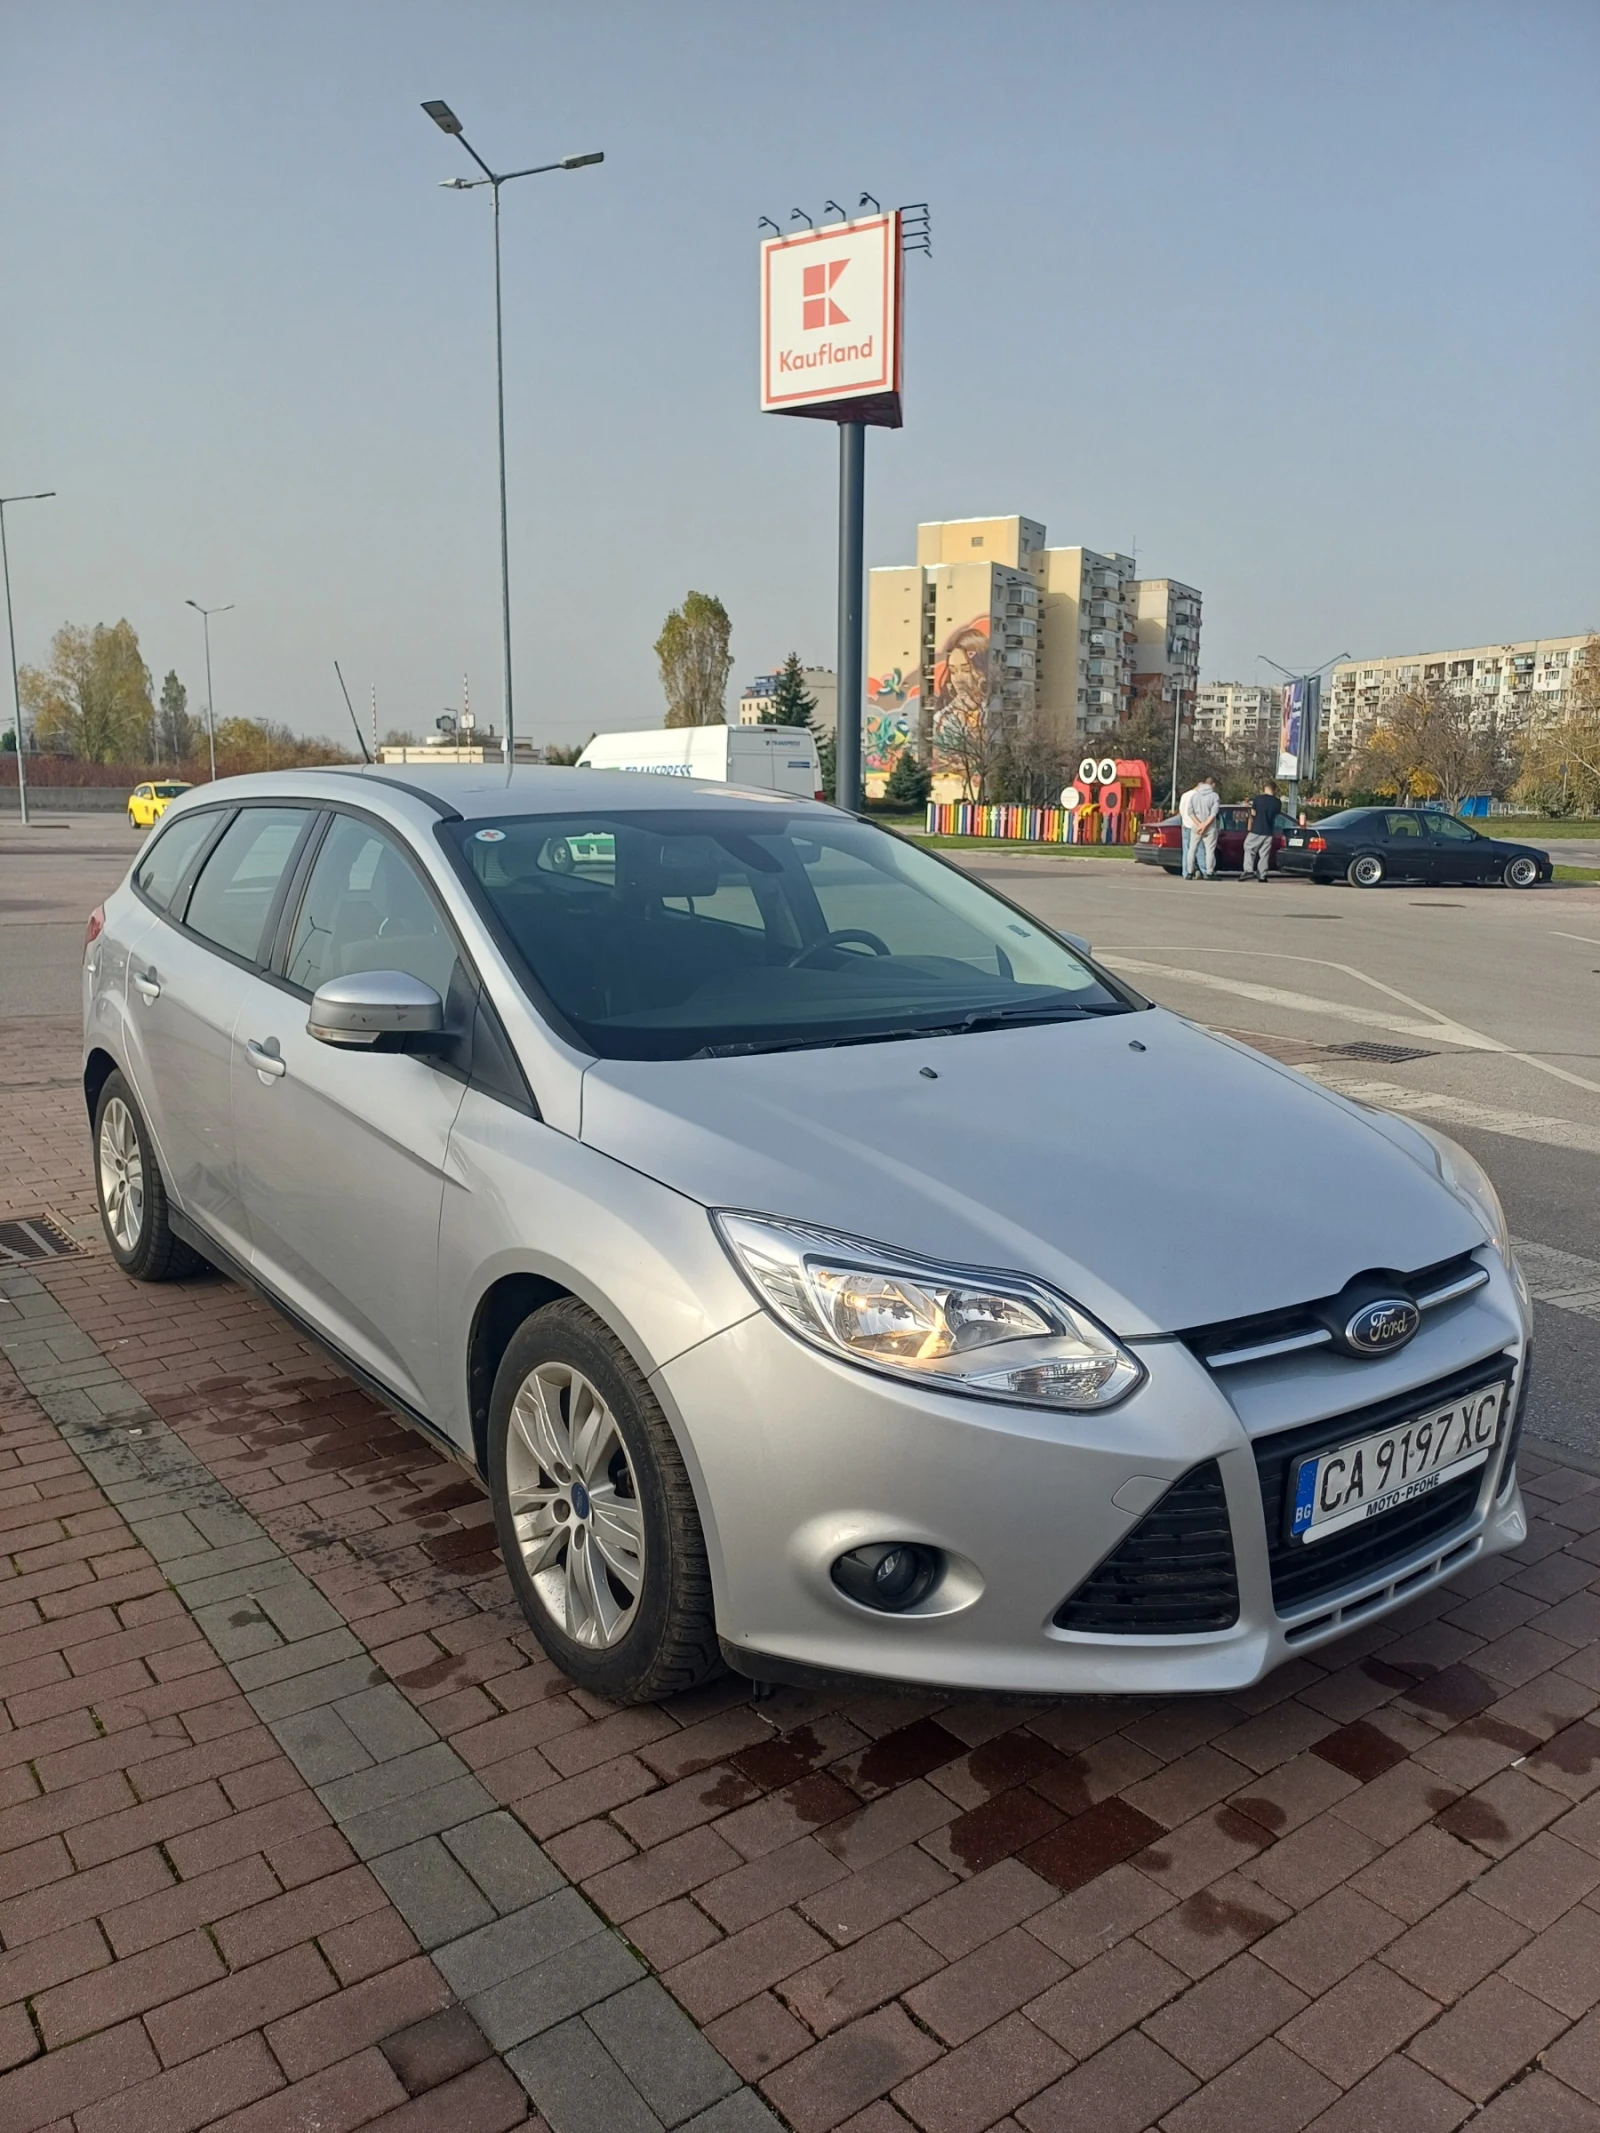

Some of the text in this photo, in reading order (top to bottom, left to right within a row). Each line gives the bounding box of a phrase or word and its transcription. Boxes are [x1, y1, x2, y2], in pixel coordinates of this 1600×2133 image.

[803, 258, 851, 330] K
[779, 335, 873, 372] Kaufland
[1370, 1308, 1408, 1341] Ford
[1320, 1395, 1496, 1512] CA 9197 XC
[1295, 1503, 1312, 1523] BG
